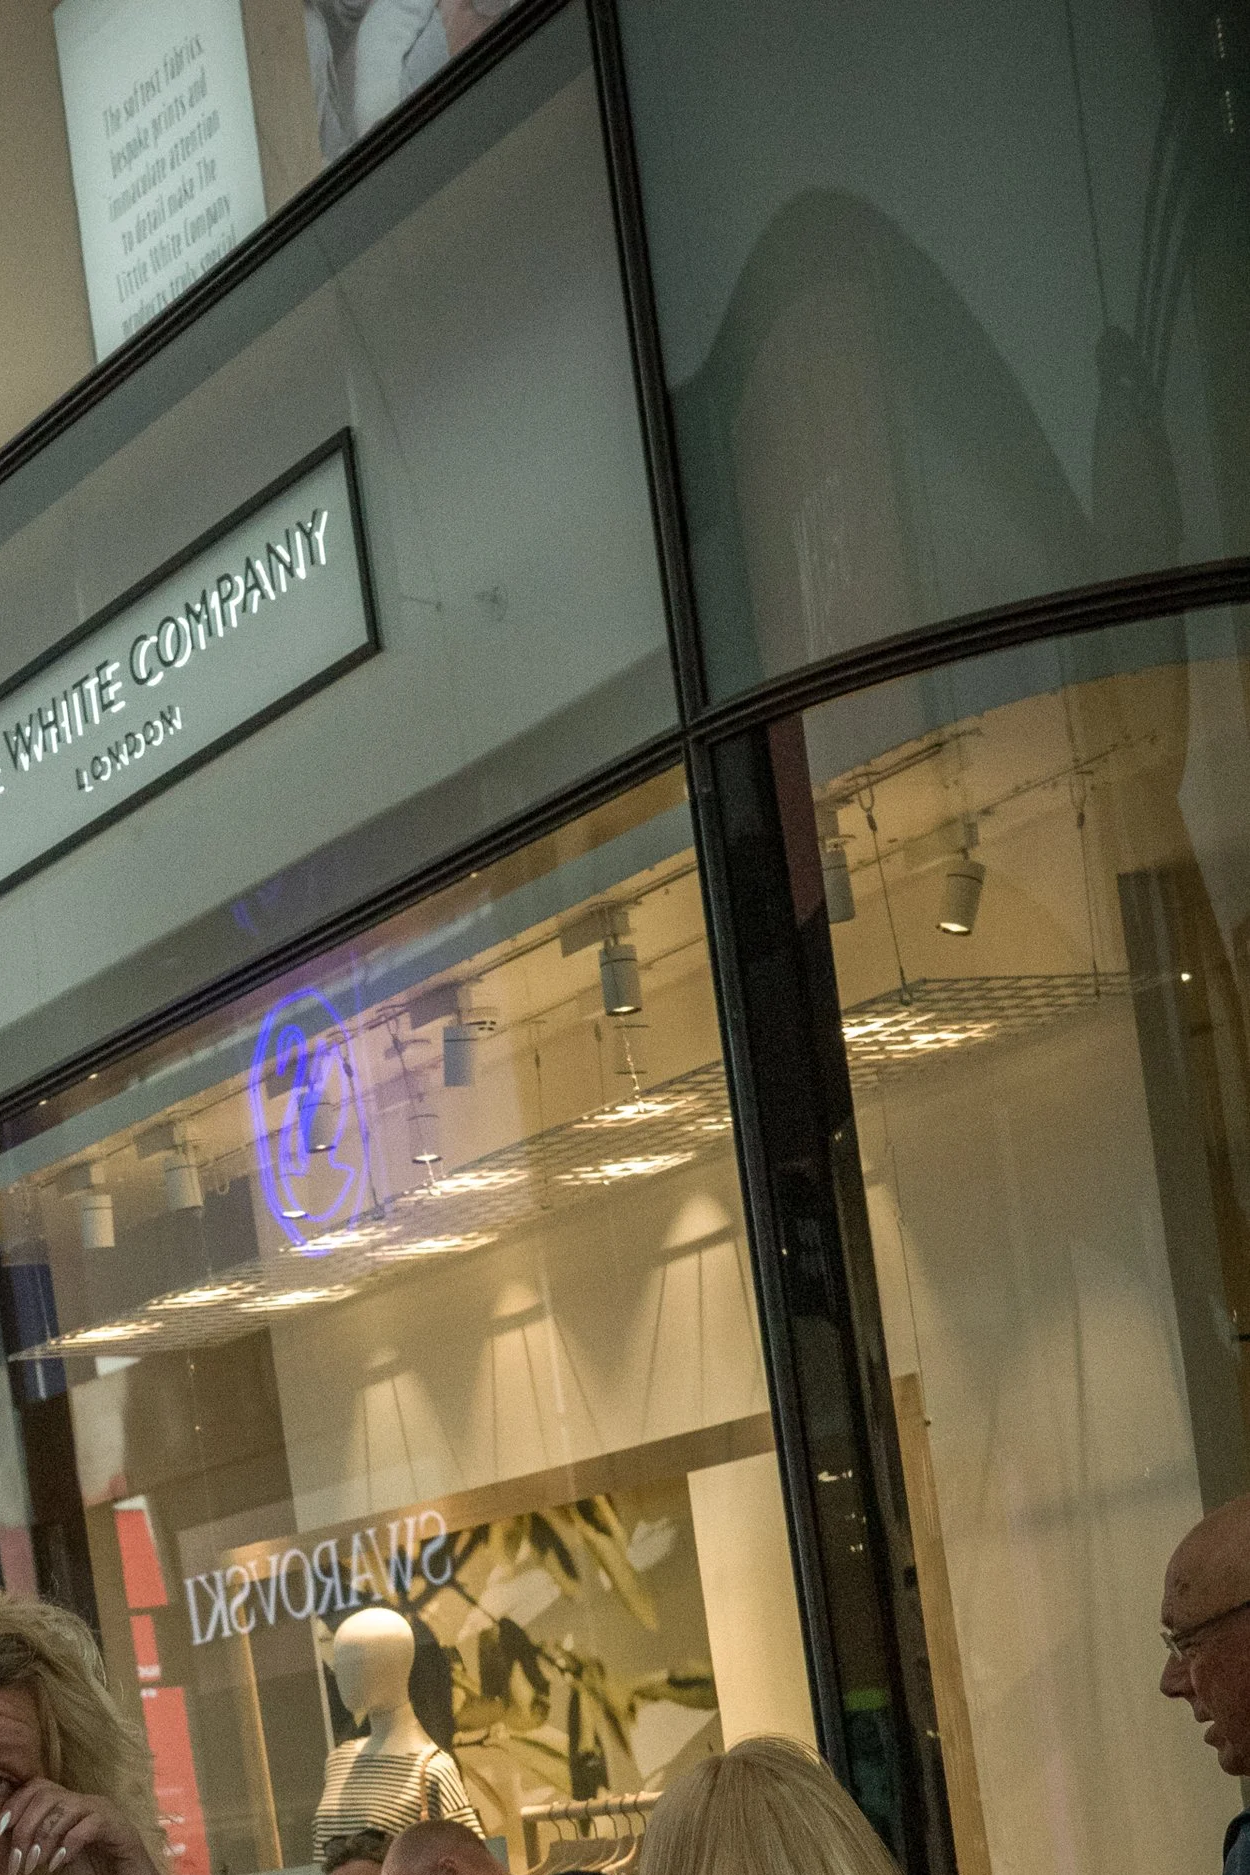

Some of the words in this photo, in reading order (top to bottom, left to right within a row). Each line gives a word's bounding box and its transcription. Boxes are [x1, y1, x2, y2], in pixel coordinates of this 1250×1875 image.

[102, 105, 121, 139] The
[123, 68, 161, 122] softest
[163, 33, 204, 86] fabrics
[110, 124, 150, 179] bespoke
[152, 94, 186, 149] prints
[188, 64, 208, 109] and
[107, 158, 167, 223] immaculate
[169, 109, 220, 171] attention
[121, 230, 134, 255] to
[135, 195, 166, 245] detail
[167, 175, 194, 217] make
[196, 157, 216, 192] The
[116, 257, 149, 303] Little
[150, 232, 182, 275] White
[183, 193, 230, 248] Company
[3, 660, 126, 772] WHITE
[130, 507, 328, 686] COMPANY
[76, 705, 183, 793] LONDON
